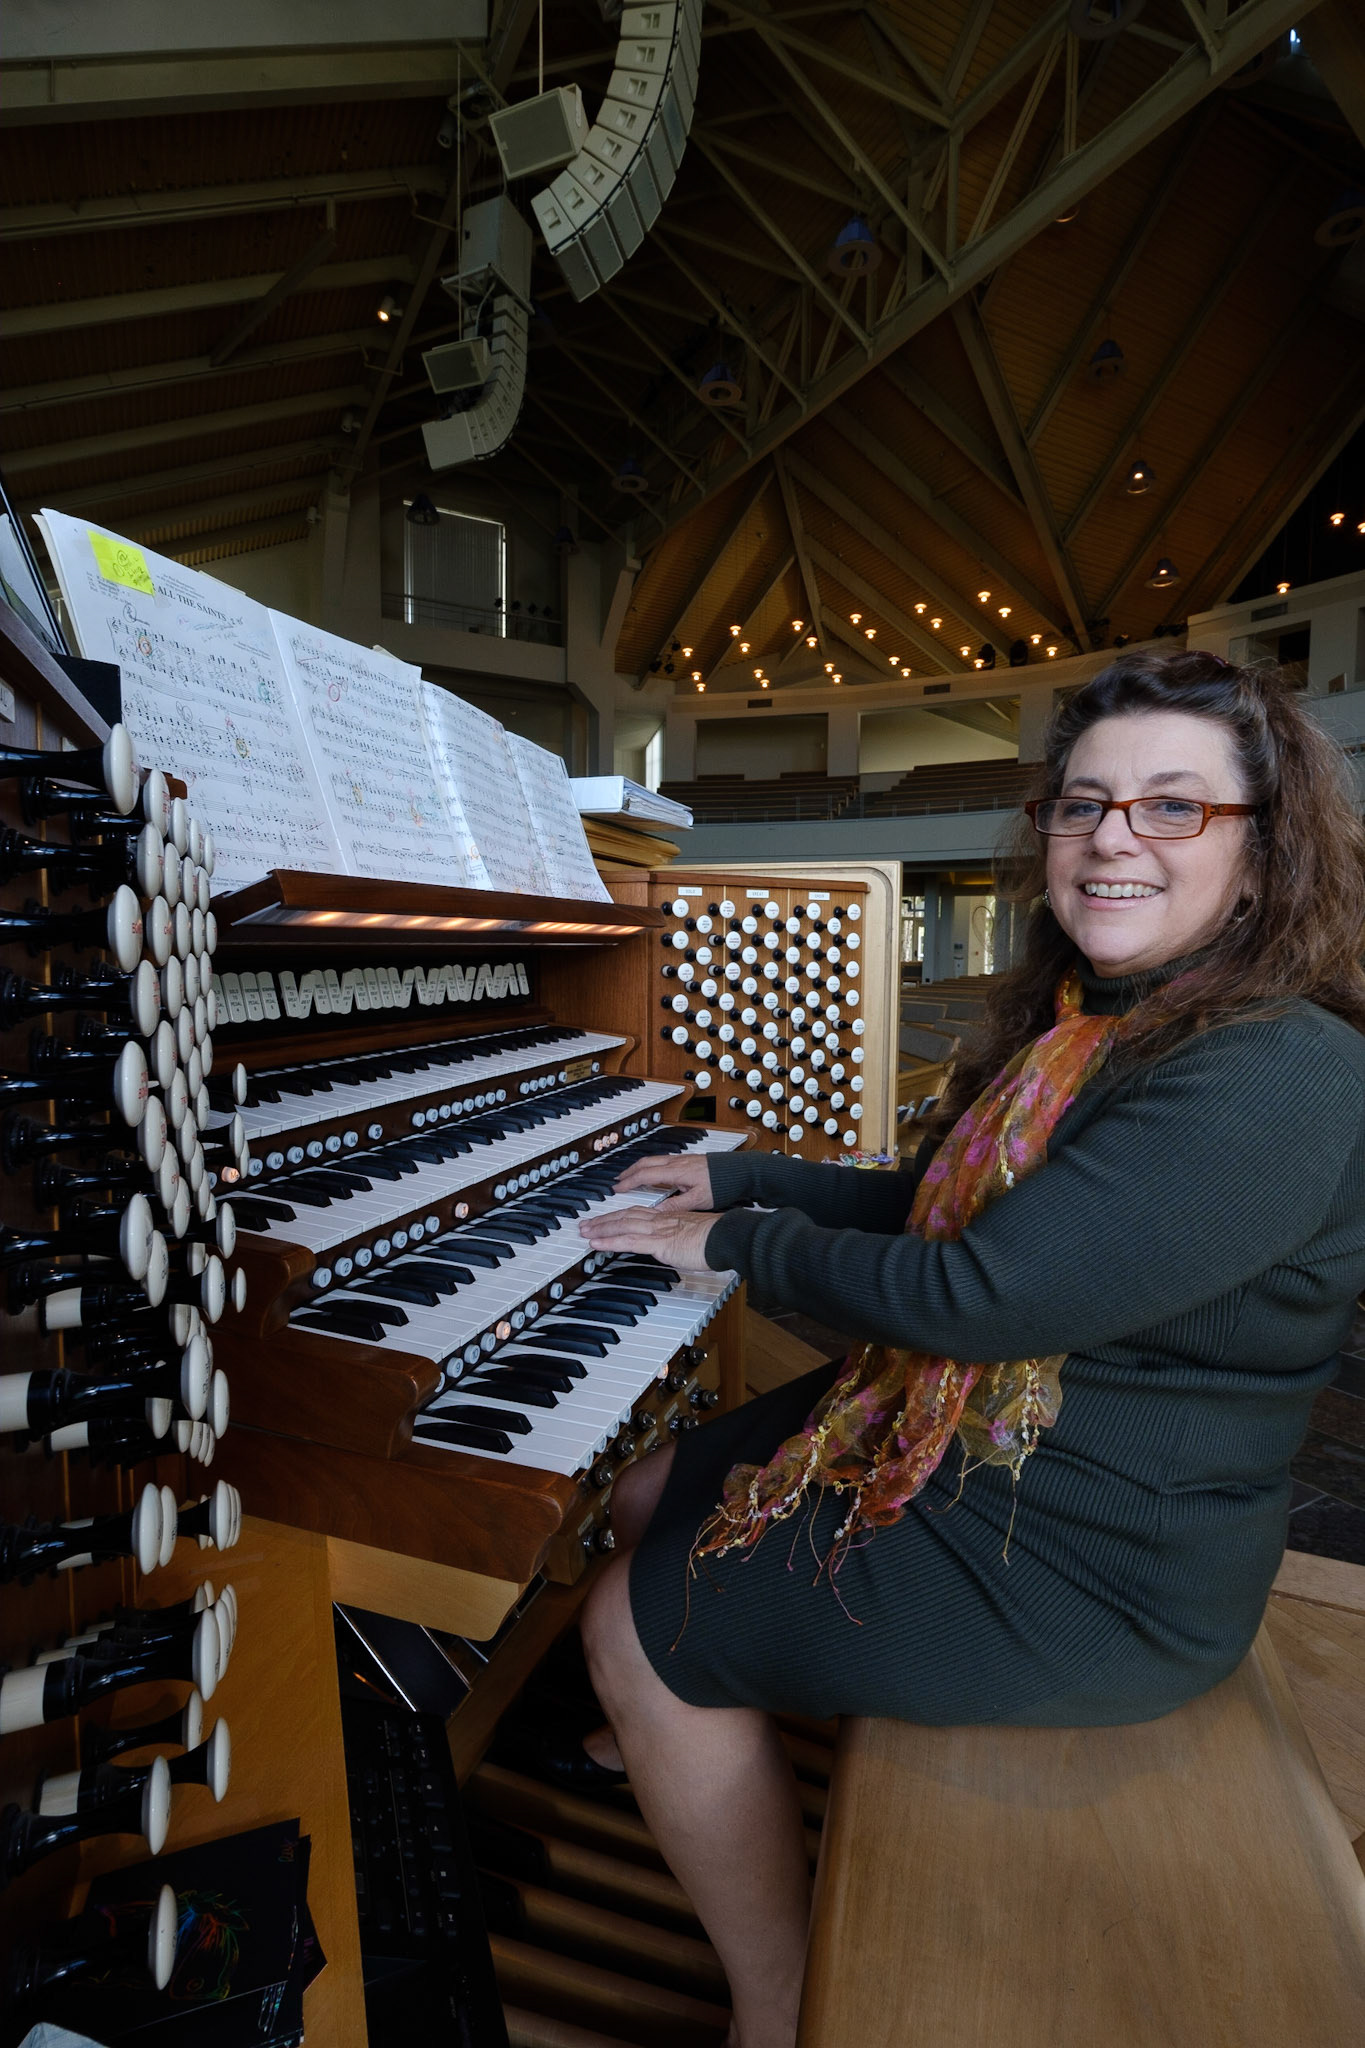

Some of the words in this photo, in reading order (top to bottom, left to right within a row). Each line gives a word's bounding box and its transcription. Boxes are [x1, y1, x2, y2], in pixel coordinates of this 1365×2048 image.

[157, 586, 176, 600] ALL
[178, 595, 197, 610] THE
[197, 602, 227, 622] SAINTS
